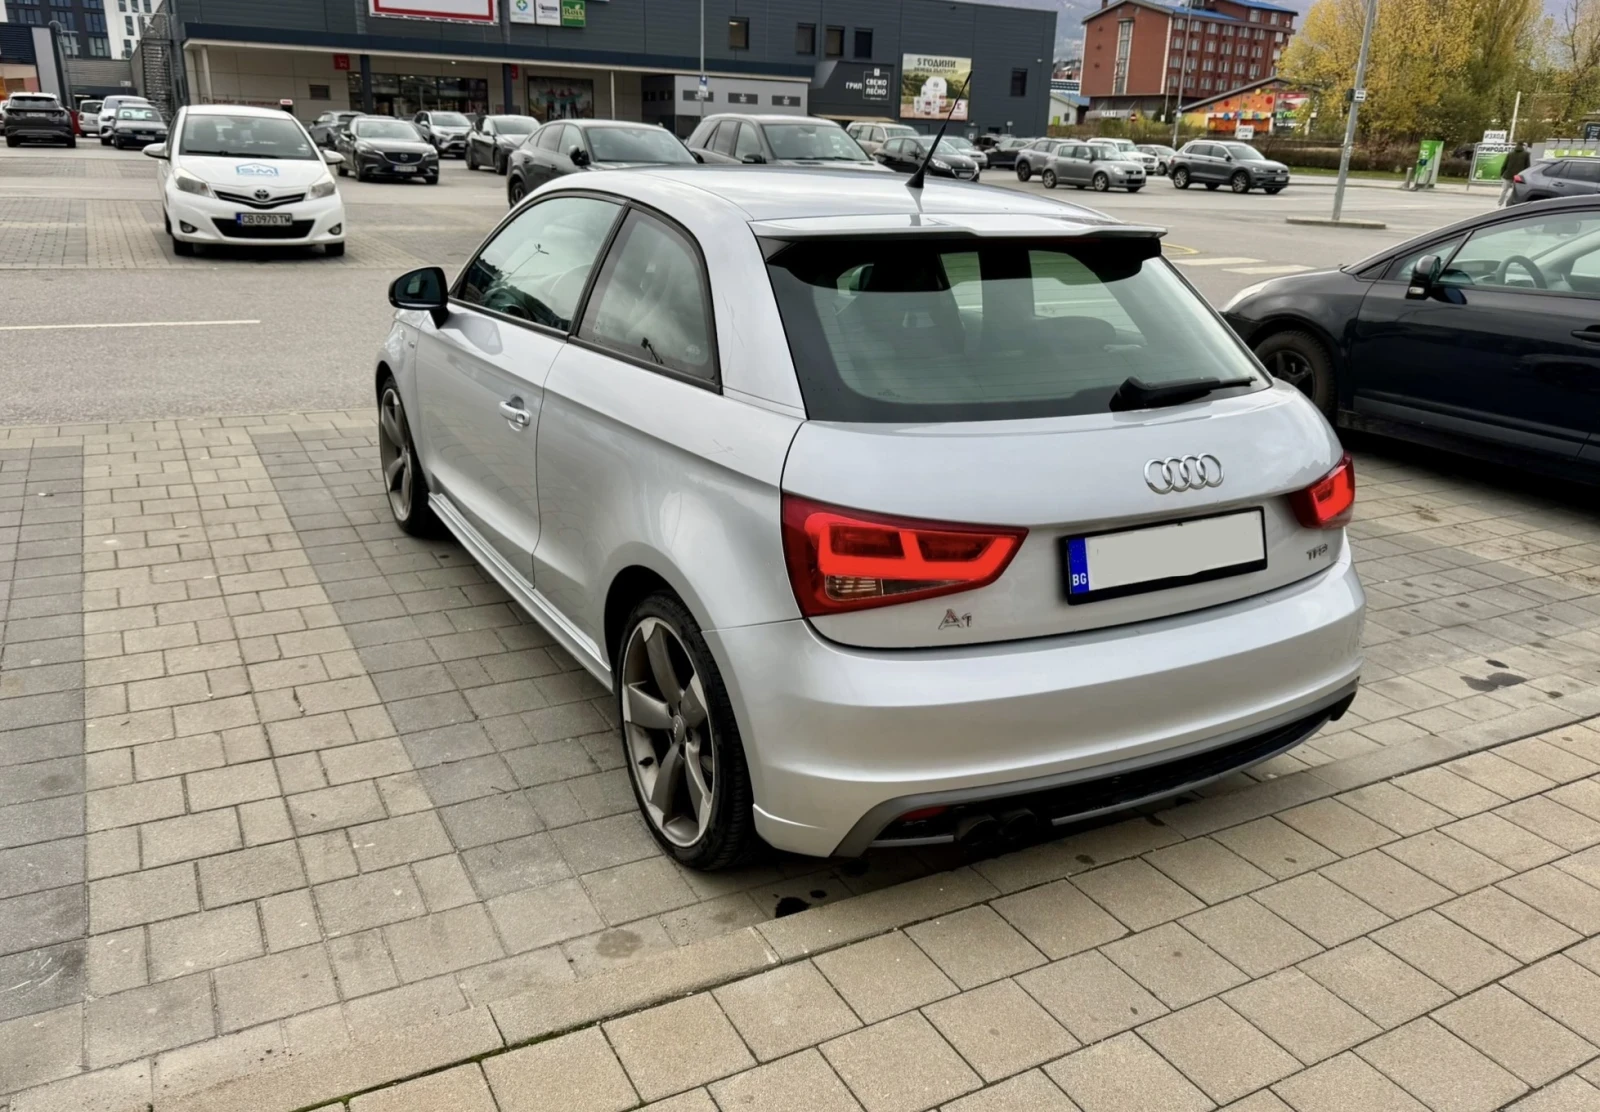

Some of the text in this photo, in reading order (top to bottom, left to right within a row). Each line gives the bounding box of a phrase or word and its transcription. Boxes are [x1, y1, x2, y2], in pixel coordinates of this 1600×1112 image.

[916, 58, 956, 68] 5 ГОДИНИ
[865, 78, 887, 86] СВЕЖО
[1484, 132, 1505, 140] ИЗХОД
[256, 214, 278, 224] 0970
[1072, 572, 1087, 586] BG
[937, 608, 973, 631] A1
